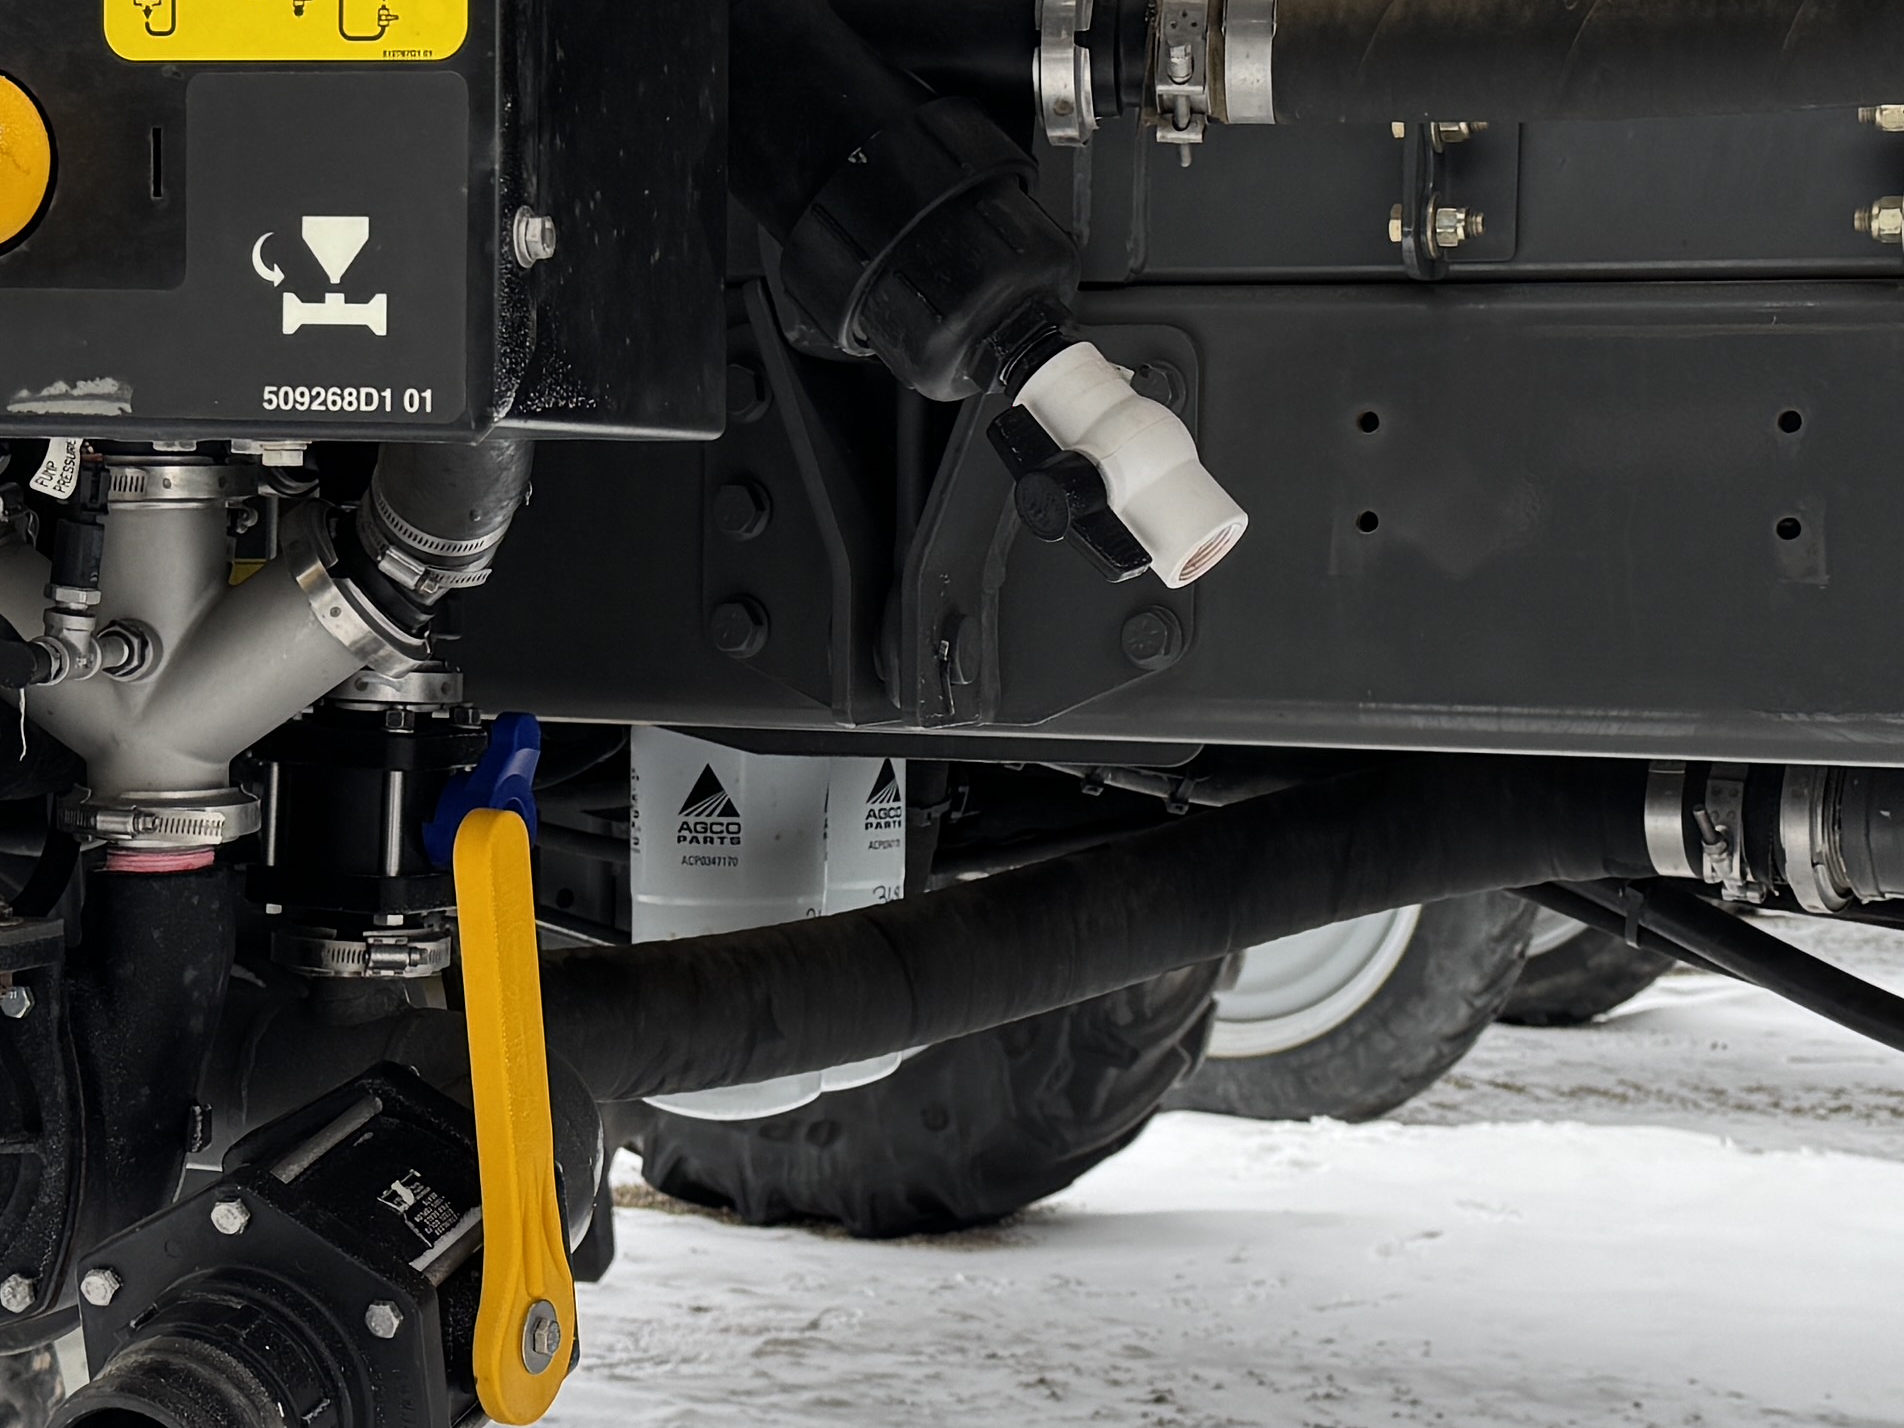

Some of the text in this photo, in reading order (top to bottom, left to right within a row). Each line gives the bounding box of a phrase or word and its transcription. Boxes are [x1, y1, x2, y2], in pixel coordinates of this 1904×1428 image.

[262, 385, 433, 413] 509268D1 01
[52, 440, 77, 494] PRESSURE
[677, 821, 742, 834] AGCO
[677, 835, 741, 845] PARTS
